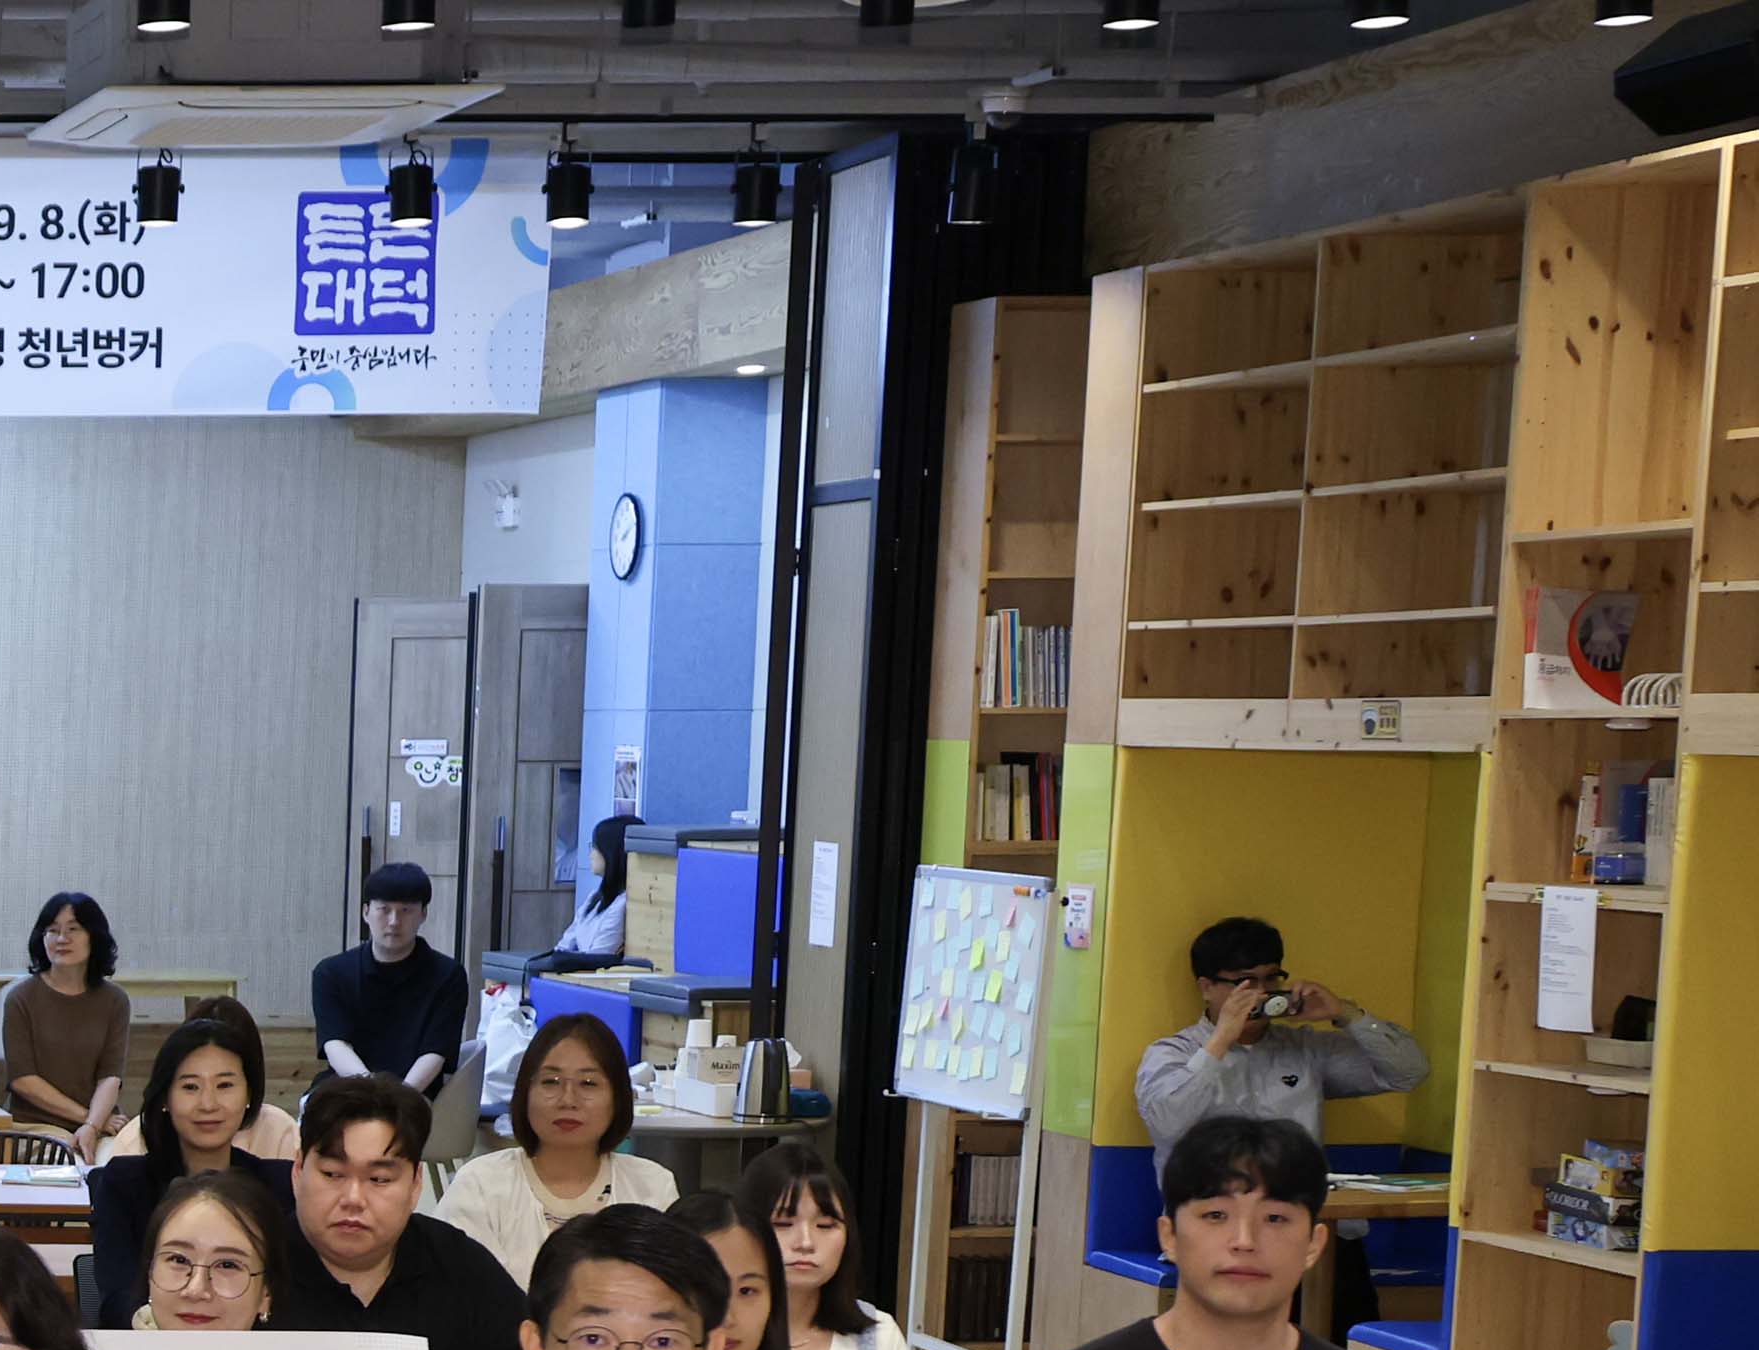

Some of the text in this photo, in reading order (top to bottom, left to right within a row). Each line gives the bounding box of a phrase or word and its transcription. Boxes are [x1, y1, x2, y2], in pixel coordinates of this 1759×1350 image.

[40, 199, 147, 245] 8.(화)
[31, 262, 146, 299] 17:00
[301, 268, 430, 328] 대덕
[19, 328, 163, 369] 청년벙커
